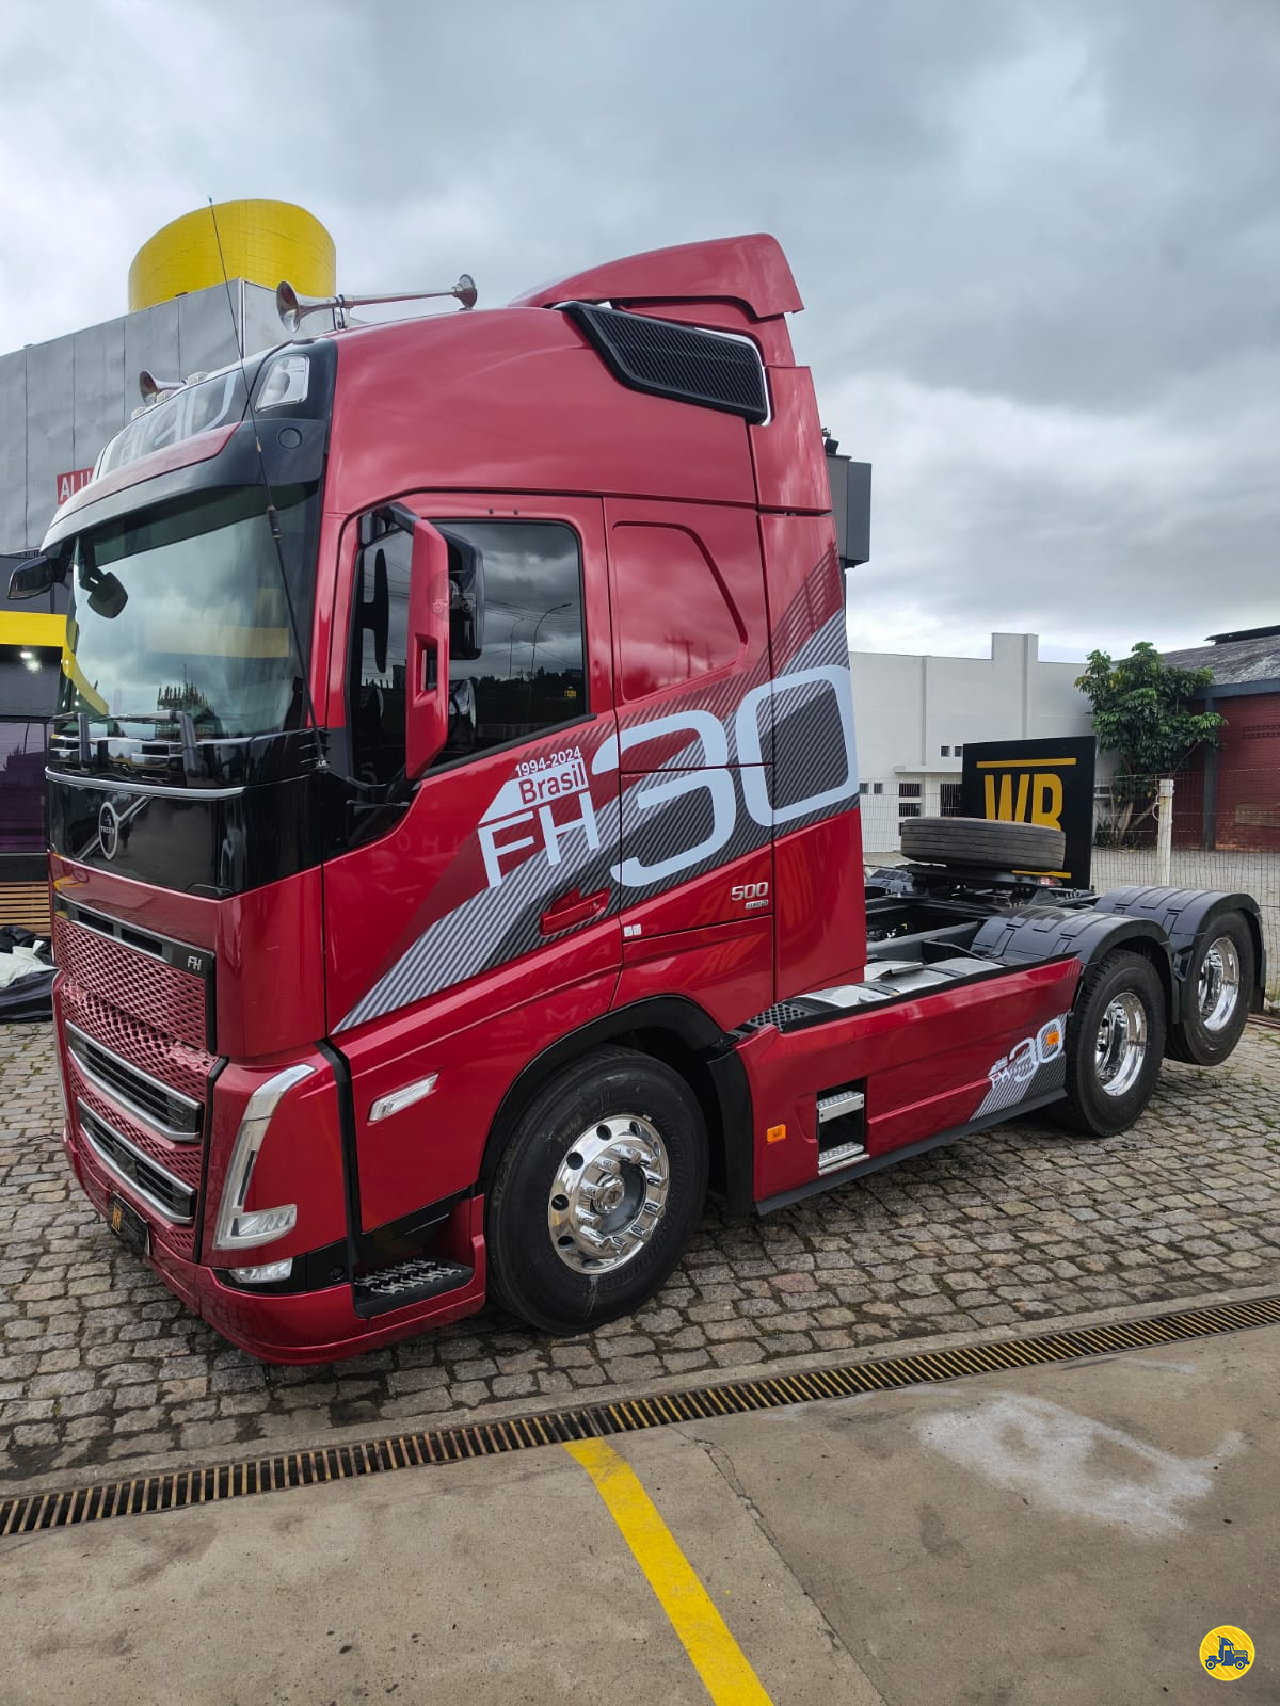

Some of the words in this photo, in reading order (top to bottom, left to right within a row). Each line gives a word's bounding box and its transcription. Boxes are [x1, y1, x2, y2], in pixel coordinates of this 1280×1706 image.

[477, 791, 600, 889] FH
[591, 664, 860, 887] 30
[514, 745, 582, 777] 1994-2024
[518, 762, 586, 805] Brasil
[731, 881, 769, 901] 500
[187, 955, 203, 971] FH
